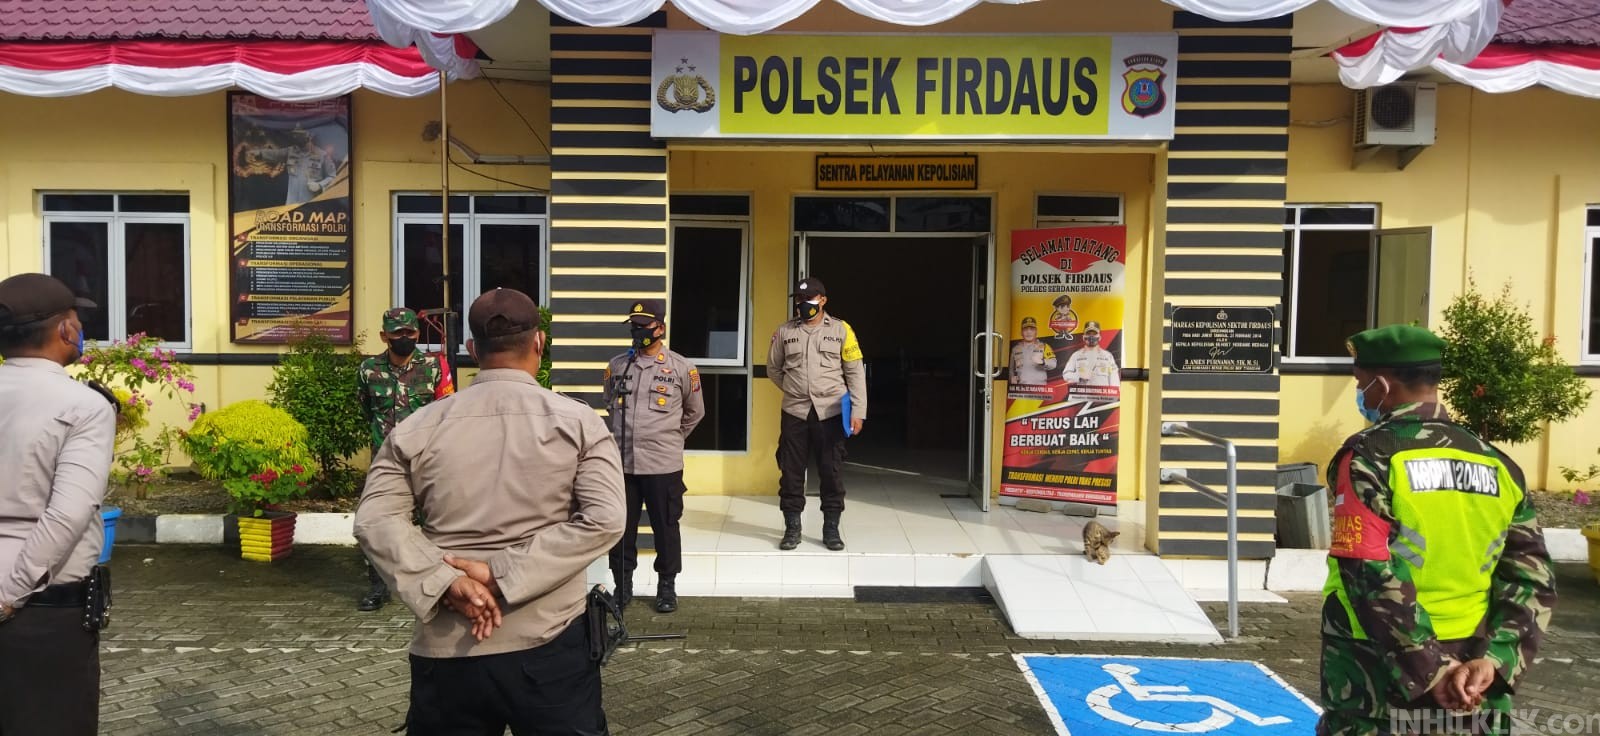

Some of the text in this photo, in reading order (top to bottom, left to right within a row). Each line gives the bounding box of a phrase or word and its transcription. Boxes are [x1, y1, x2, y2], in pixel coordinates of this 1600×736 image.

[733, 56, 1098, 116] POLSEK FIRDAUS
[819, 164, 974, 181] SENTRA PELAYANAN KEPOLISIAN
[255, 210, 346, 223] ROAD MAP
[256, 223, 346, 233] TRANSFORMASI POLRI
[1019, 237, 1120, 266] SELAMAT DATANG
[1060, 258, 1072, 270] DI
[1020, 273, 1113, 285] POLSEK FIRDAUS
[1021, 285, 1047, 293] POLRES
[1048, 285, 1080, 293] SERDANG
[1195, 321, 1227, 329] KEPOLISIAN
[1249, 321, 1271, 329] FIRDAUS
[653, 375, 675, 384] POLRI
[1031, 417, 1070, 430] TERUS
[1074, 416, 1098, 429] LAH
[1010, 434, 1066, 447] BERBUAT
[1069, 433, 1099, 446] BAIK
[1452, 461, 1498, 495] 204/DS
